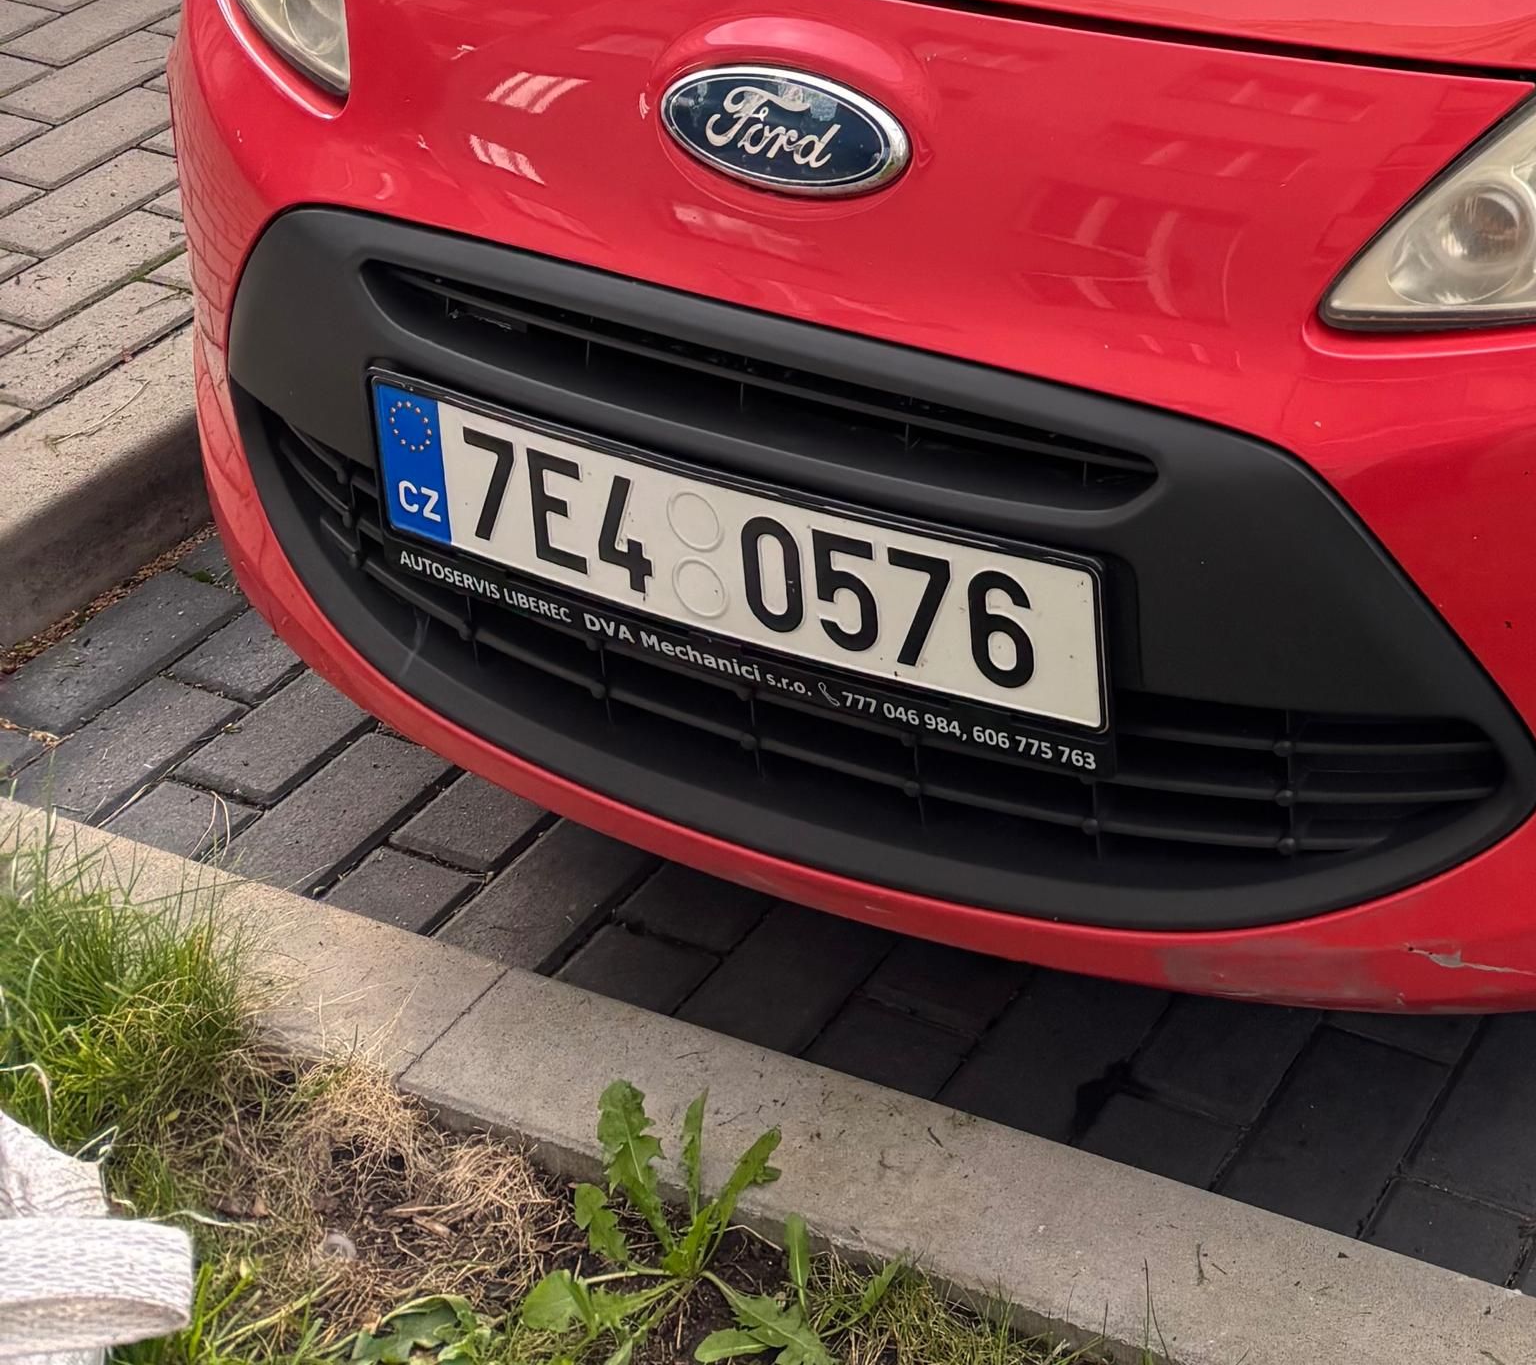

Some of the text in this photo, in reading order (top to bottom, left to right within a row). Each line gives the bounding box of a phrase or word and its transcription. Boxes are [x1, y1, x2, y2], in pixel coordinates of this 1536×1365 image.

[706, 85, 842, 168] Ford
[398, 480, 442, 523] CZ
[462, 426, 1036, 689] 7E4 0576
[400, 550, 1097, 771] AUTOSERVIS LIBEREC DVA Mechanici s.r.o. 777 046 984, 606 775 763
